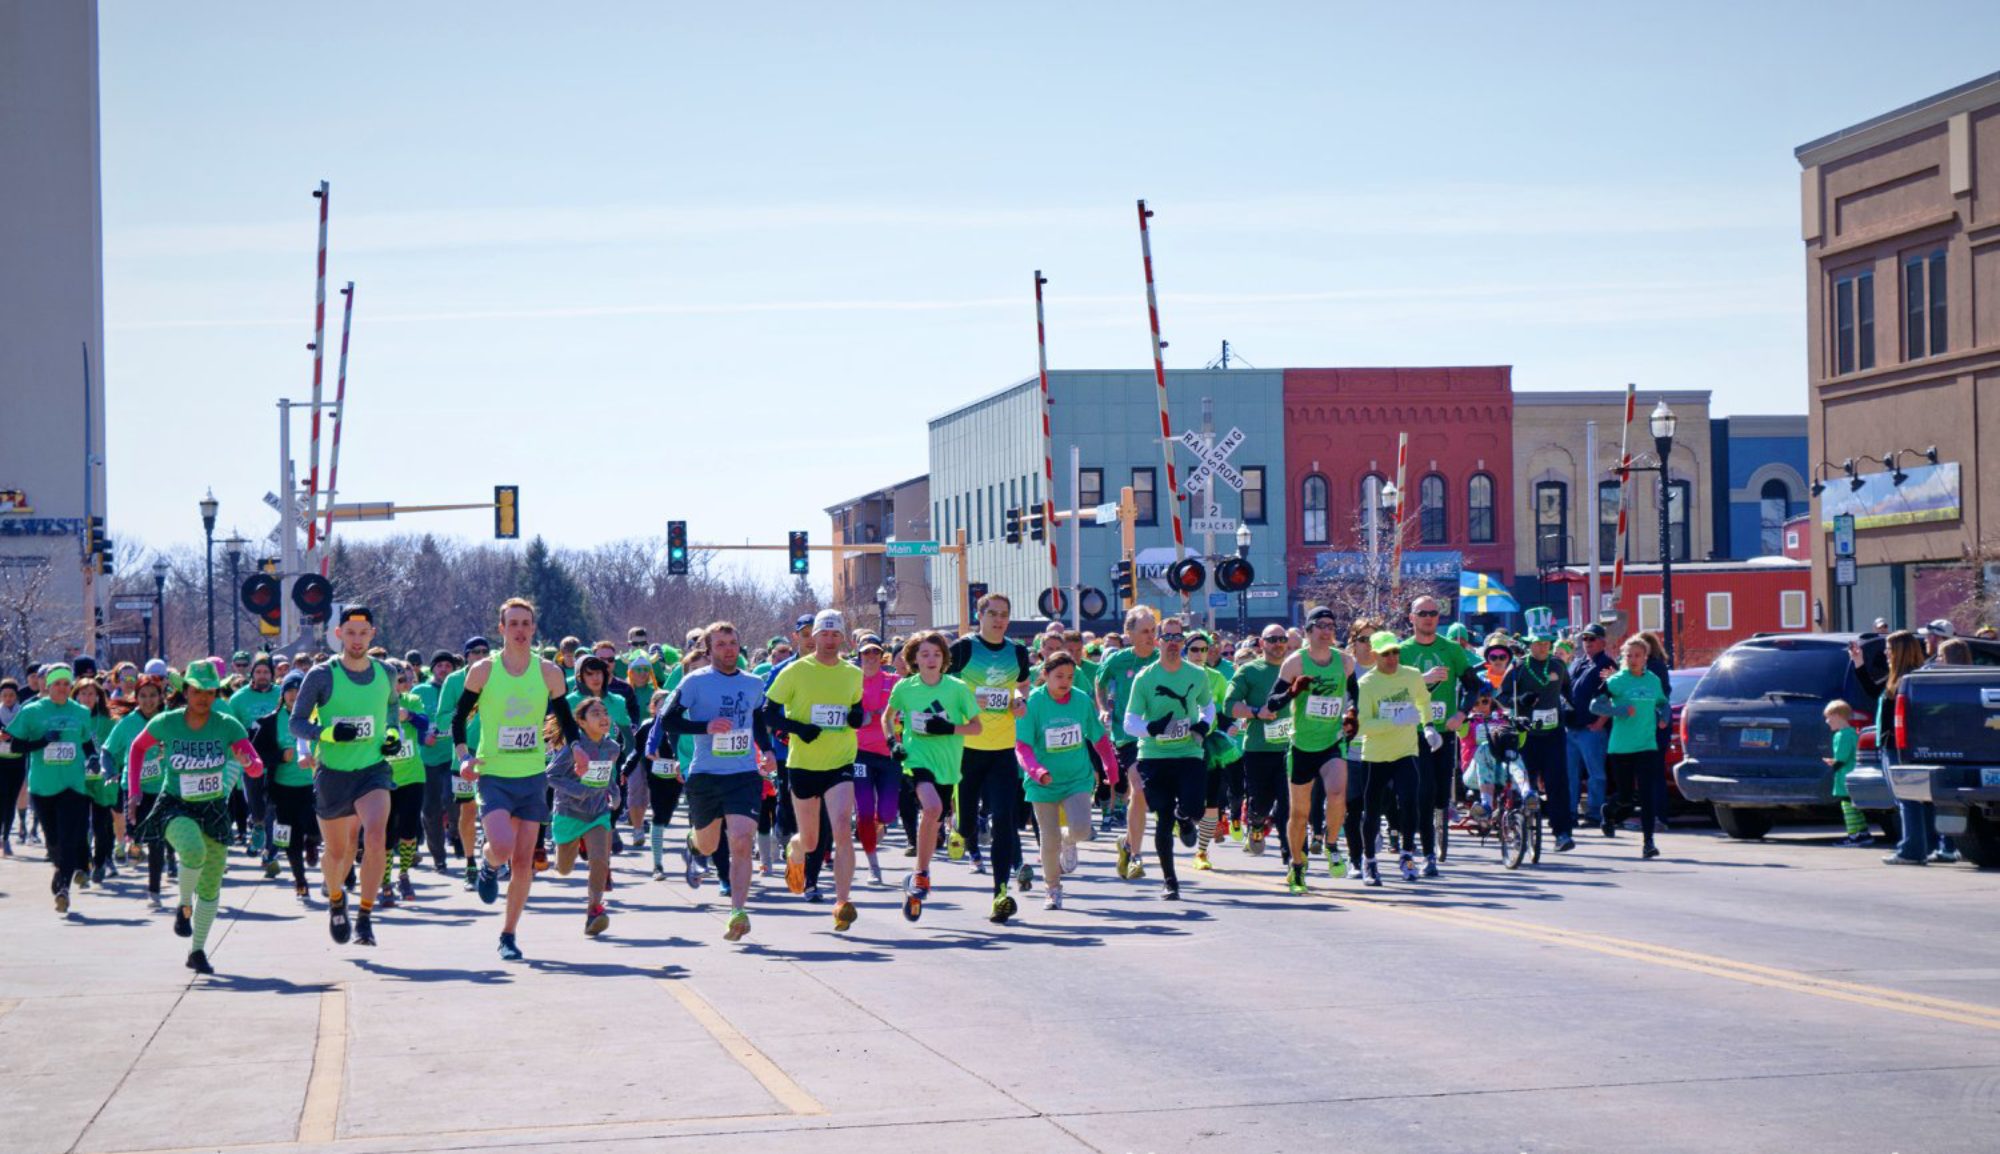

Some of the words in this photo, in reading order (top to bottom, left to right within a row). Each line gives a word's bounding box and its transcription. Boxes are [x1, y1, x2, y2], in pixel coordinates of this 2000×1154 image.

[1187, 430, 1242, 492] CROSSING
[1209, 505, 1218, 517] 2
[1193, 521, 1235, 531] TRACKS
[888, 543, 912, 555] Main
[919, 543, 938, 554] Ave
[988, 693, 1009, 708] 384
[1320, 702, 1339, 716] 513
[827, 711, 847, 726] 371
[515, 731, 536, 748] 424
[730, 735, 749, 751] 139
[1060, 729, 1081, 746] 271
[56, 747, 74, 759] 209
[172, 739, 225, 758] CHEERS
[169, 753, 225, 770] Bitches
[197, 775, 220, 792] 458
